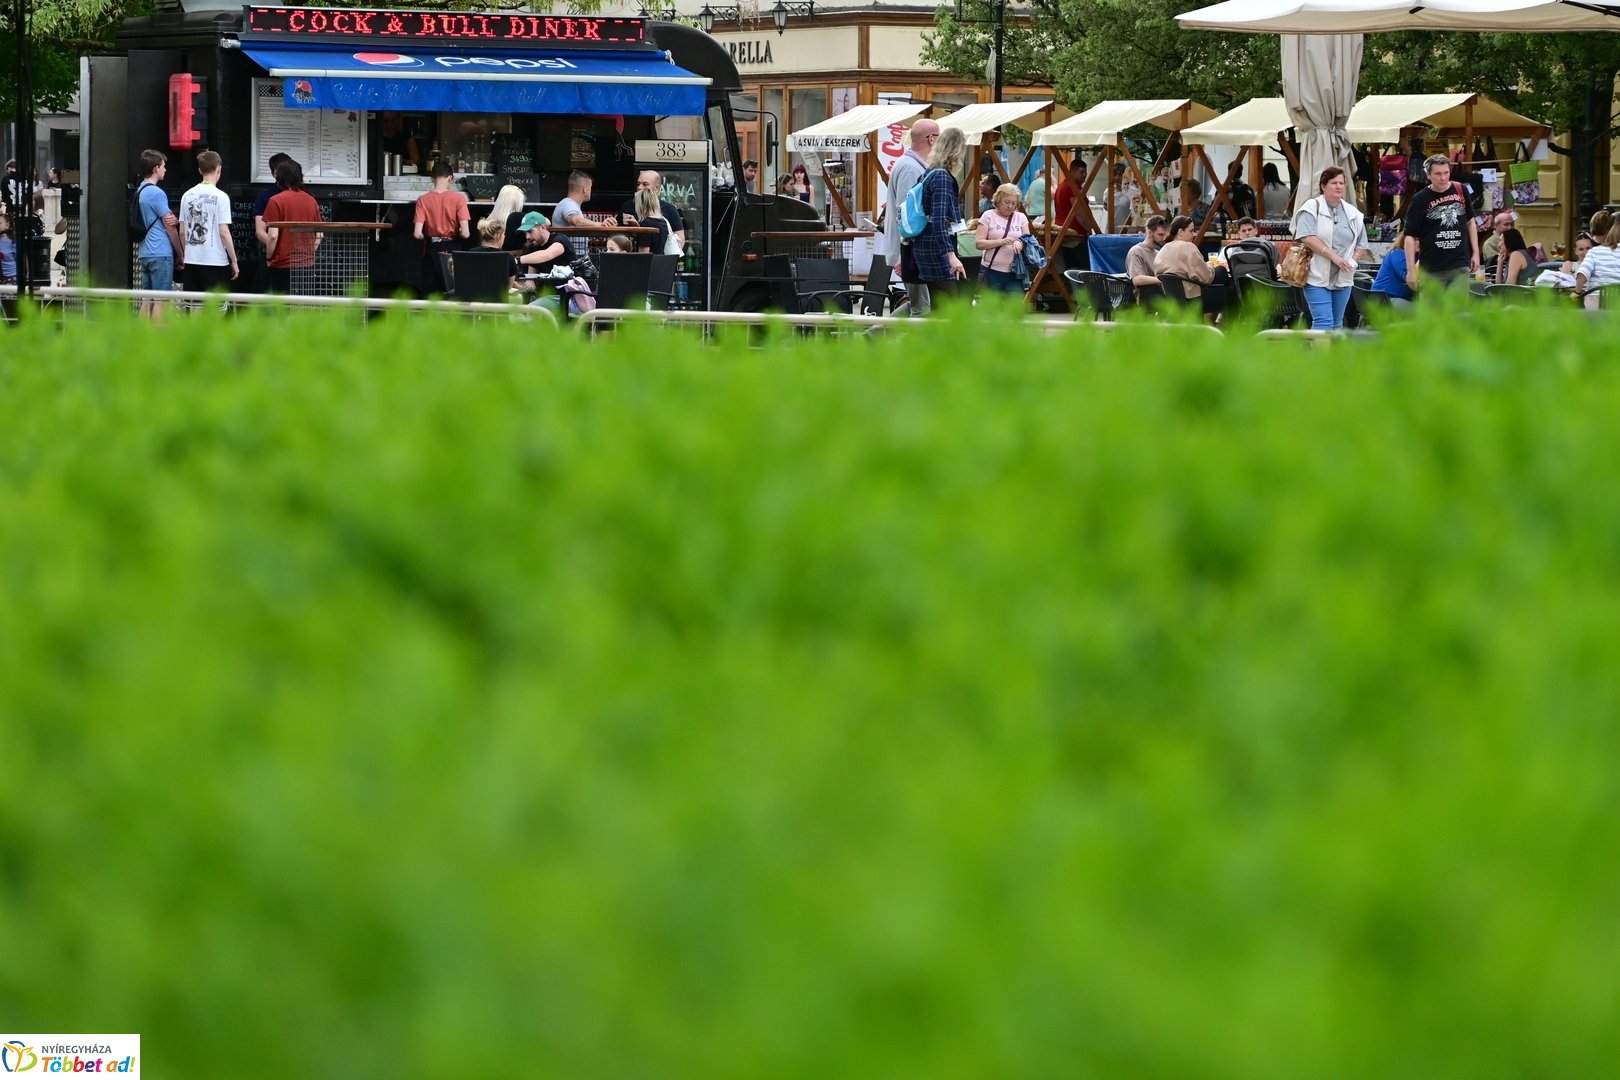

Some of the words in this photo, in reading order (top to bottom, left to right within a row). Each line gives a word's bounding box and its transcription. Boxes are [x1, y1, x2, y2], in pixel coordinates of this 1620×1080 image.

[289, 12, 372, 33] COCK
[388, 14, 403, 33] &
[422, 15, 494, 35] BULL
[510, 18, 601, 39] DINER
[434, 56, 578, 69] pepsi
[656, 142, 686, 158] 383
[882, 122, 909, 158] Coop
[658, 177, 696, 199] ÁRVA
